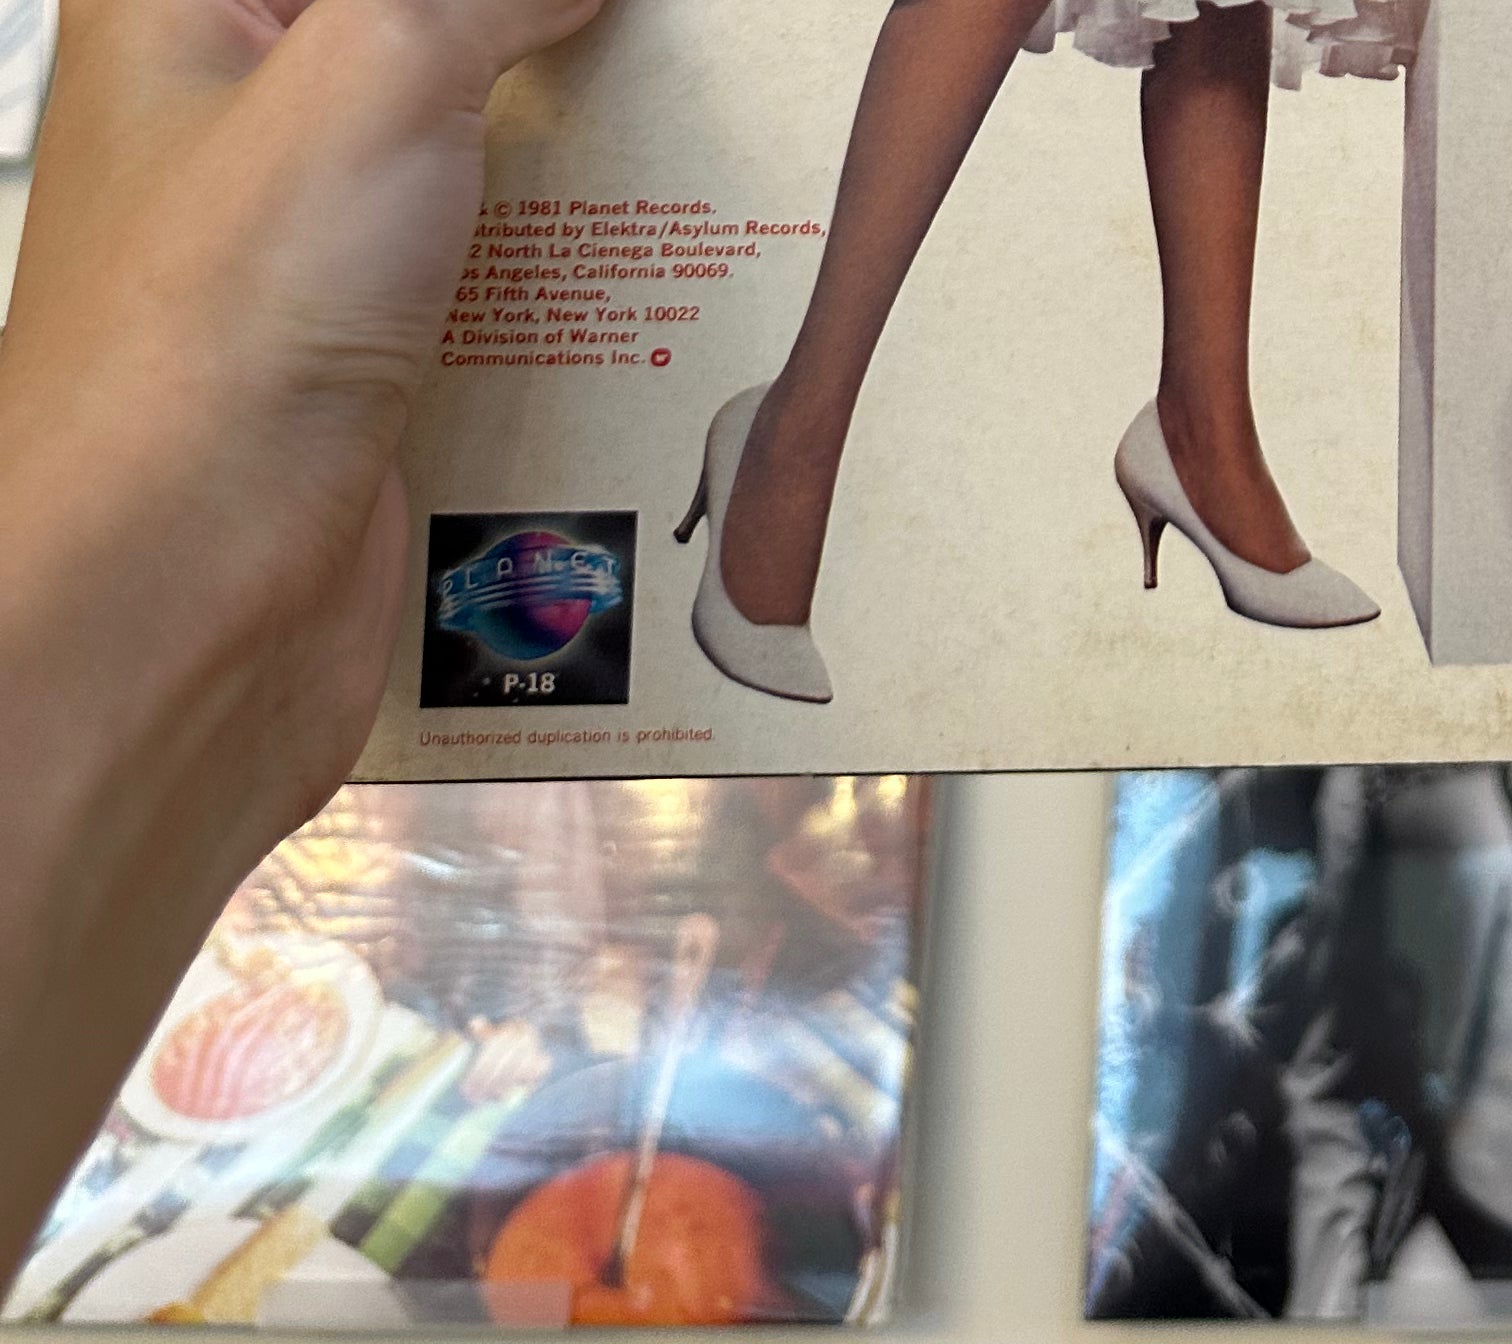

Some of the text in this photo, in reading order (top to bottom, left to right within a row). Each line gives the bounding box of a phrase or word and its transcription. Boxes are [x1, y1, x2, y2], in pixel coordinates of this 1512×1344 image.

[518, 199, 561, 216] 1981
[569, 199, 630, 216] Planet
[636, 199, 717, 215] Records.
[562, 221, 586, 241] by
[591, 220, 740, 241] Elektra/Asylum
[745, 219, 827, 238] Records,
[487, 243, 543, 259] North
[548, 243, 572, 259] La
[577, 242, 654, 261] Cienega
[660, 241, 762, 259] Boulevard,
[485, 265, 568, 283] Angeles,
[573, 264, 666, 280] California
[485, 286, 529, 302] Fifth
[534, 286, 612, 303] Avenue,
[492, 308, 541, 325] York,
[546, 307, 588, 323] New
[595, 307, 637, 322] York
[644, 306, 700, 322] 10022
[441, 328, 640, 345] A Division of Warner
[441, 350, 647, 367] Communications Inc.
[419, 729, 522, 746] Unauthorized
[527, 728, 611, 747] duplication
[616, 729, 630, 742] is
